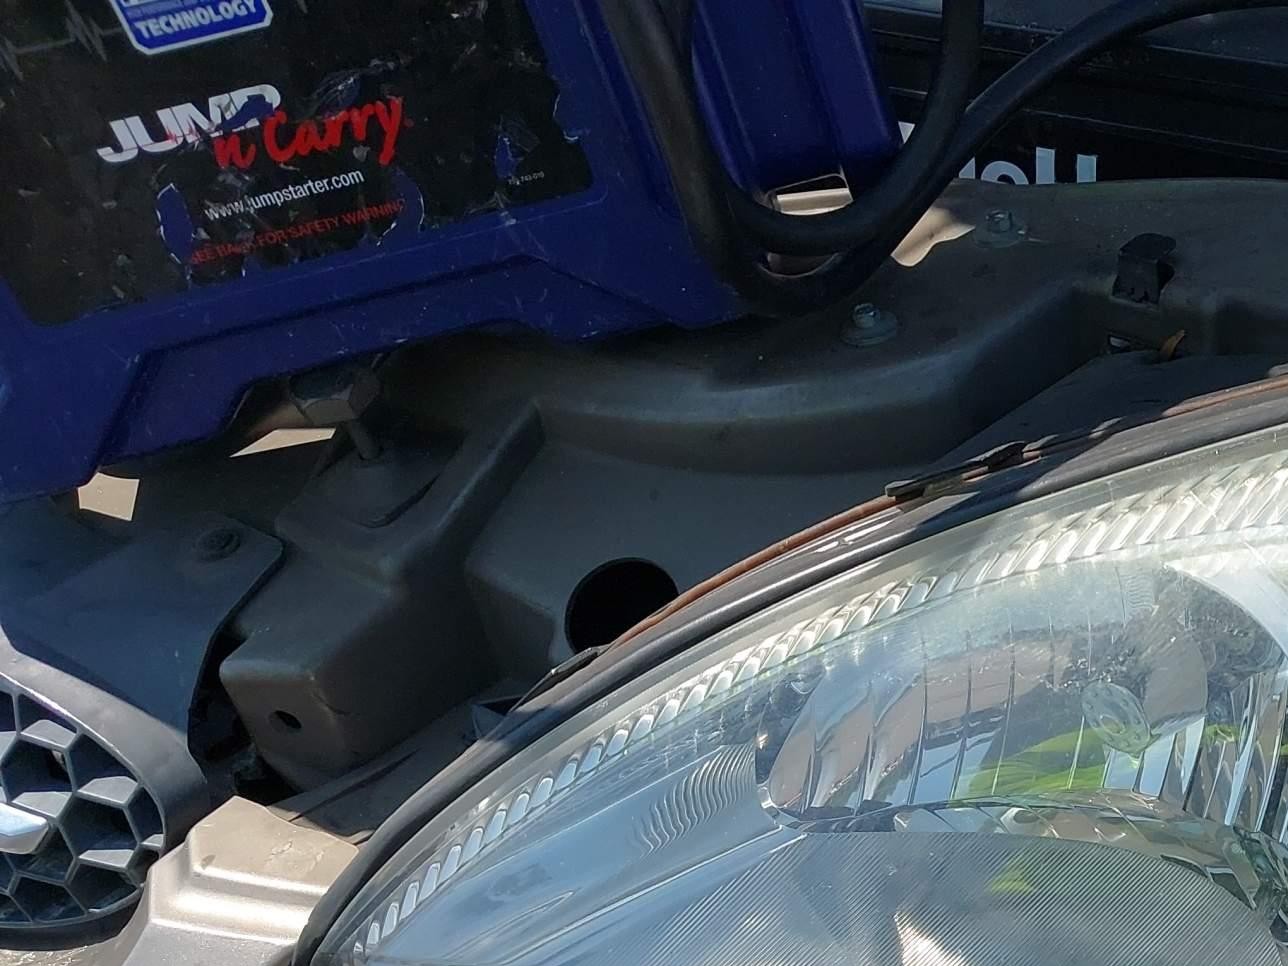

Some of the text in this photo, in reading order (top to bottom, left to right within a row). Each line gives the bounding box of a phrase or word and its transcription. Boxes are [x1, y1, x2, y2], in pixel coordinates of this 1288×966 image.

[133, 0, 257, 39] TECHNOLOGY
[97, 84, 281, 163] JUMP
[263, 95, 404, 166] Carry
[203, 169, 365, 221] www.jumpstarter.com
[257, 229, 288, 247] FOR
[288, 215, 340, 239] SAFETY
